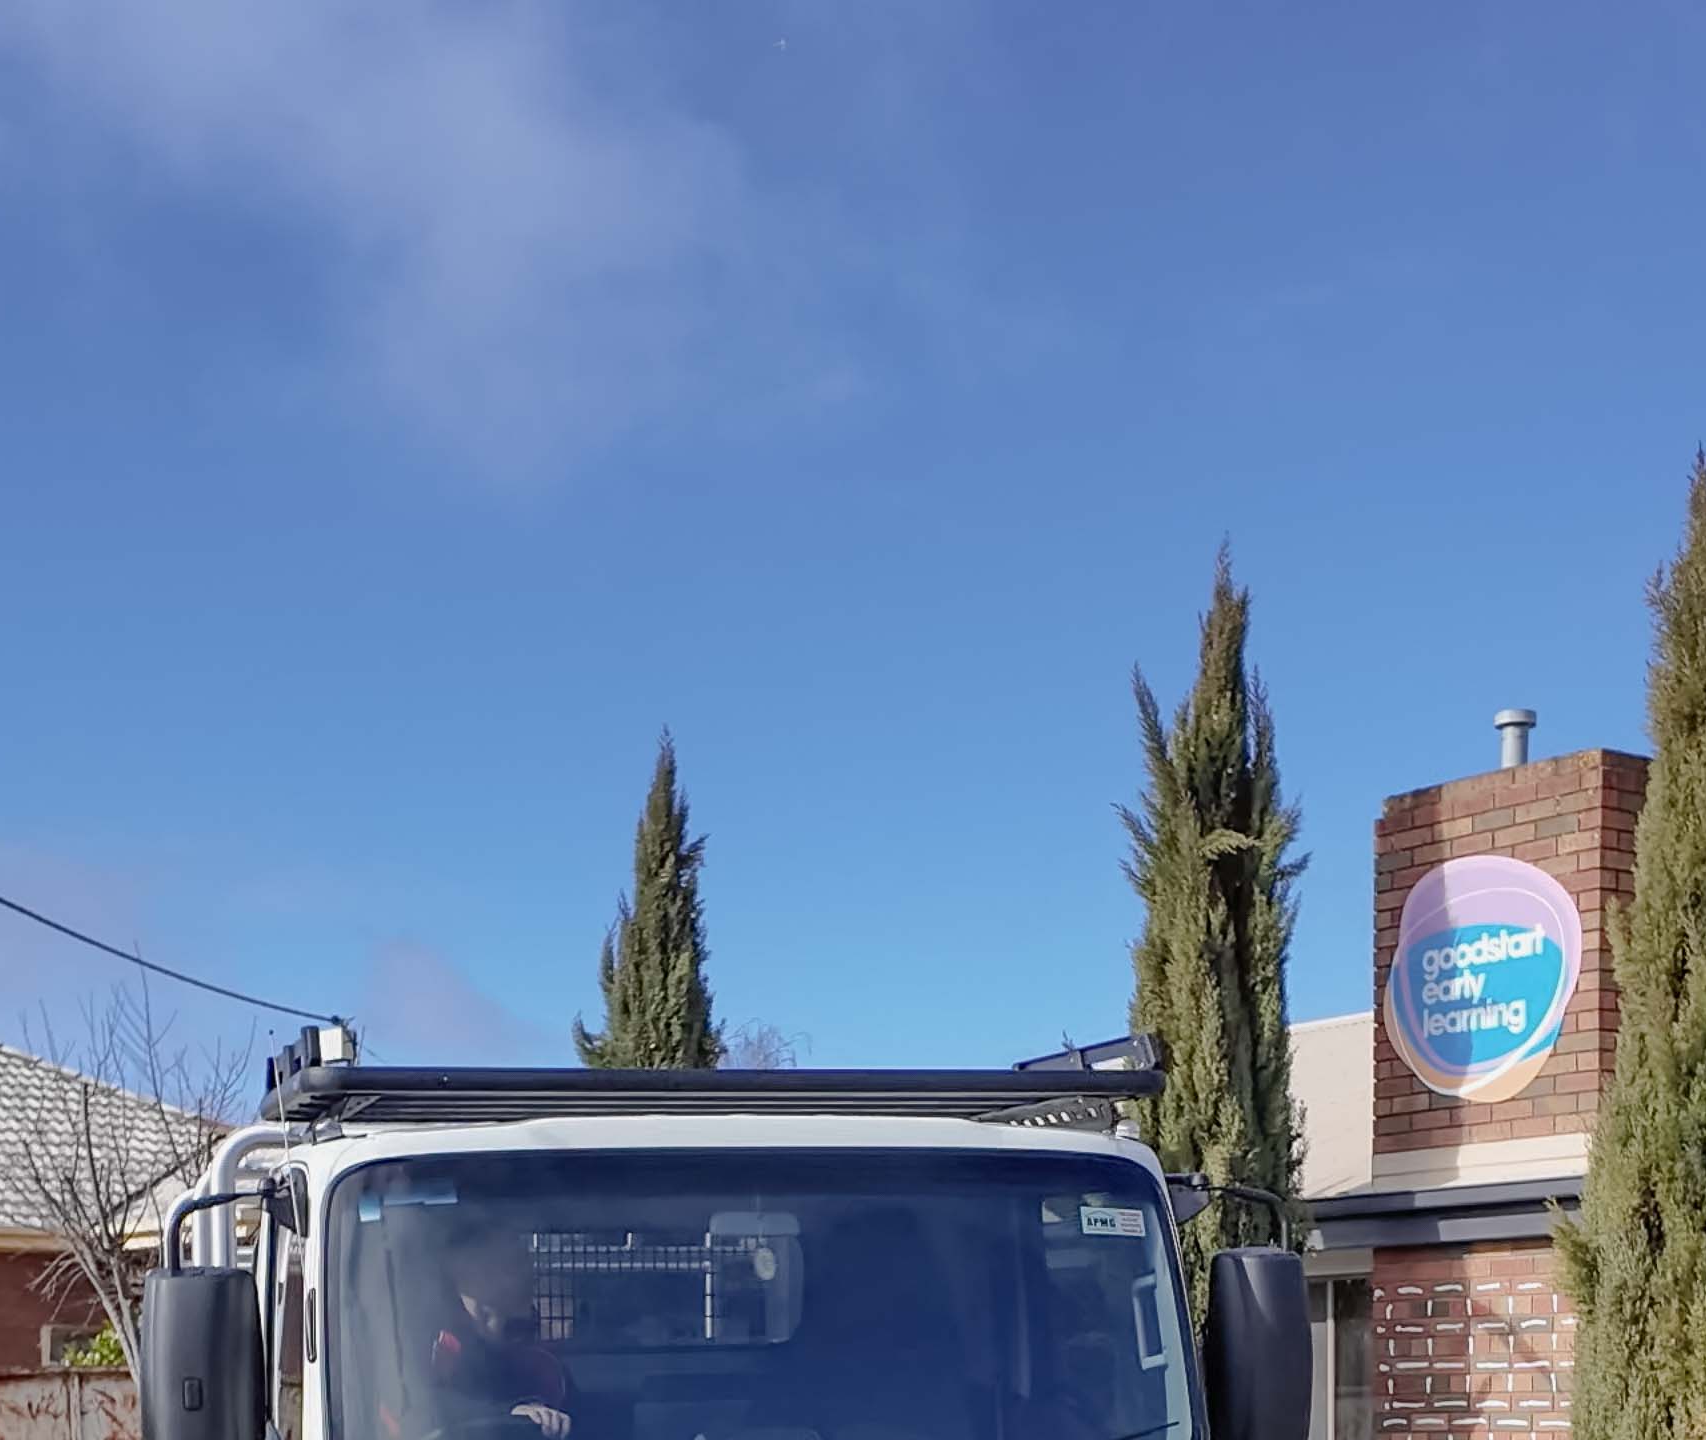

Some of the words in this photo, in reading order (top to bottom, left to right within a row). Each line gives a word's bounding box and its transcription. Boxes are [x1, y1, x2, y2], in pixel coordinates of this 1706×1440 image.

[1422, 924, 1544, 980] goodstart
[1422, 968, 1486, 1004] early
[1424, 998, 1526, 1038] learning
